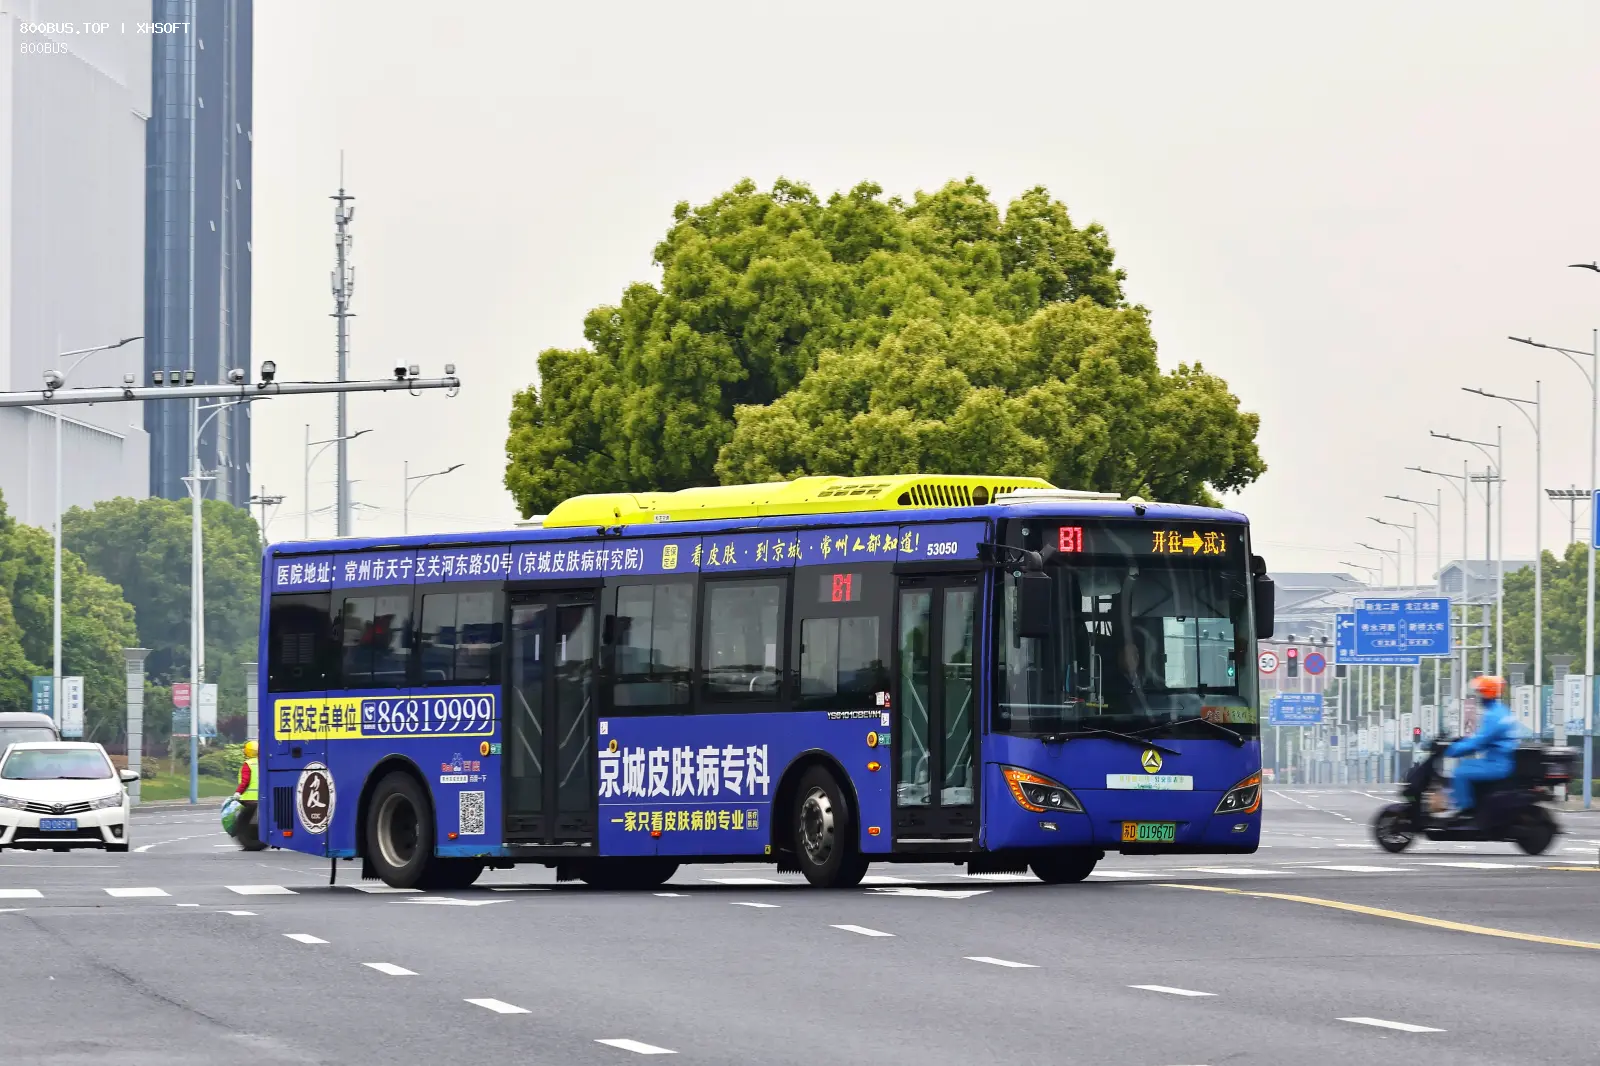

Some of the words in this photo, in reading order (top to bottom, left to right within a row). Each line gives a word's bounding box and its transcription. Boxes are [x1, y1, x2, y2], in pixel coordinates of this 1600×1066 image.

[926, 541, 958, 556] 53050
[1059, 526, 1082, 553] B1
[1152, 530, 1183, 553] 开往
[832, 573, 852, 602] B1
[1261, 657, 1275, 668] 50
[279, 704, 357, 734] 医保定点单位
[377, 697, 492, 733] 86819999
[598, 744, 771, 798] 京城皮肤病专科
[610, 809, 745, 832] 一家只看皮肤病的专业
